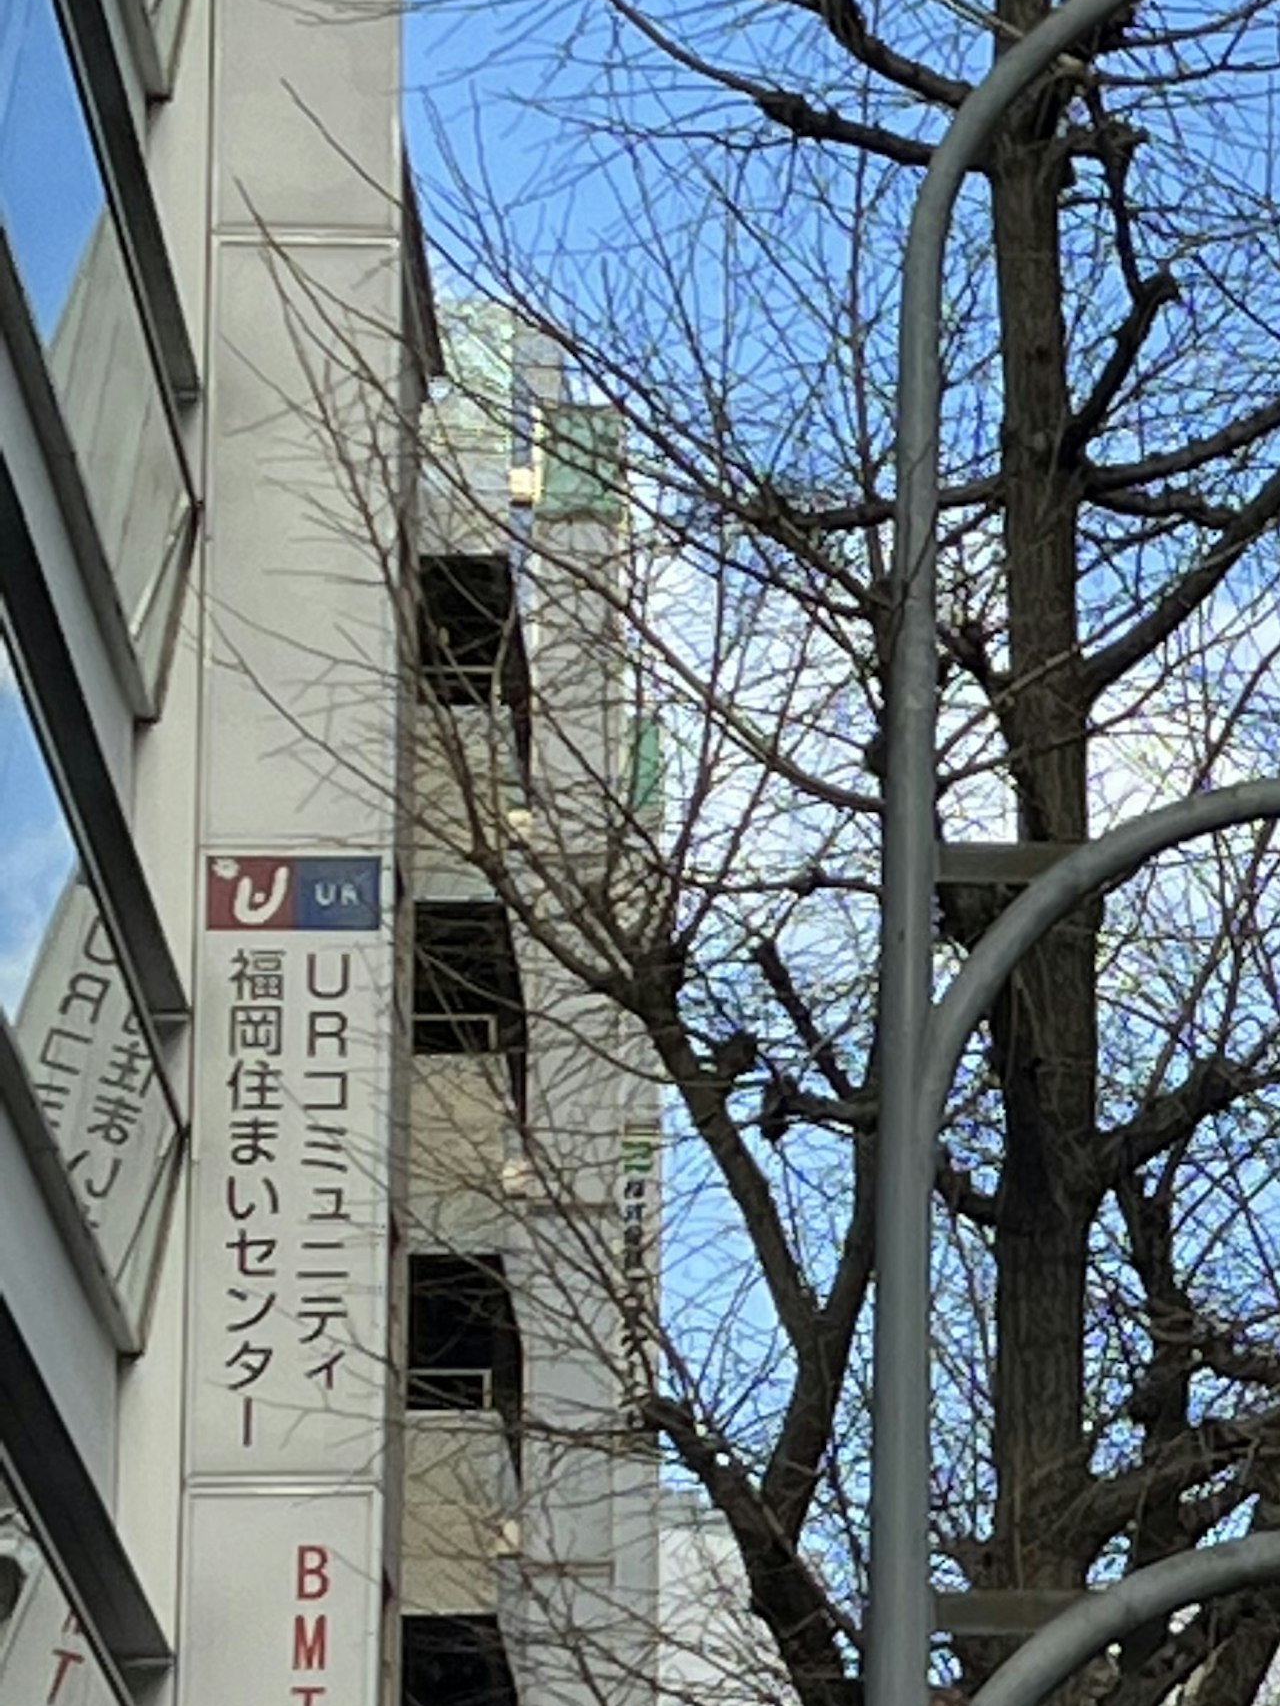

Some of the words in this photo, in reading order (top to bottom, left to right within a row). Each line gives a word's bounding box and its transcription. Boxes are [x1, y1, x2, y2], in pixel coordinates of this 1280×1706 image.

[314, 882, 359, 906] UR
[225, 948, 287, 1448] 福岡住まいセンター
[296, 951, 352, 1392] URコミュニティ
